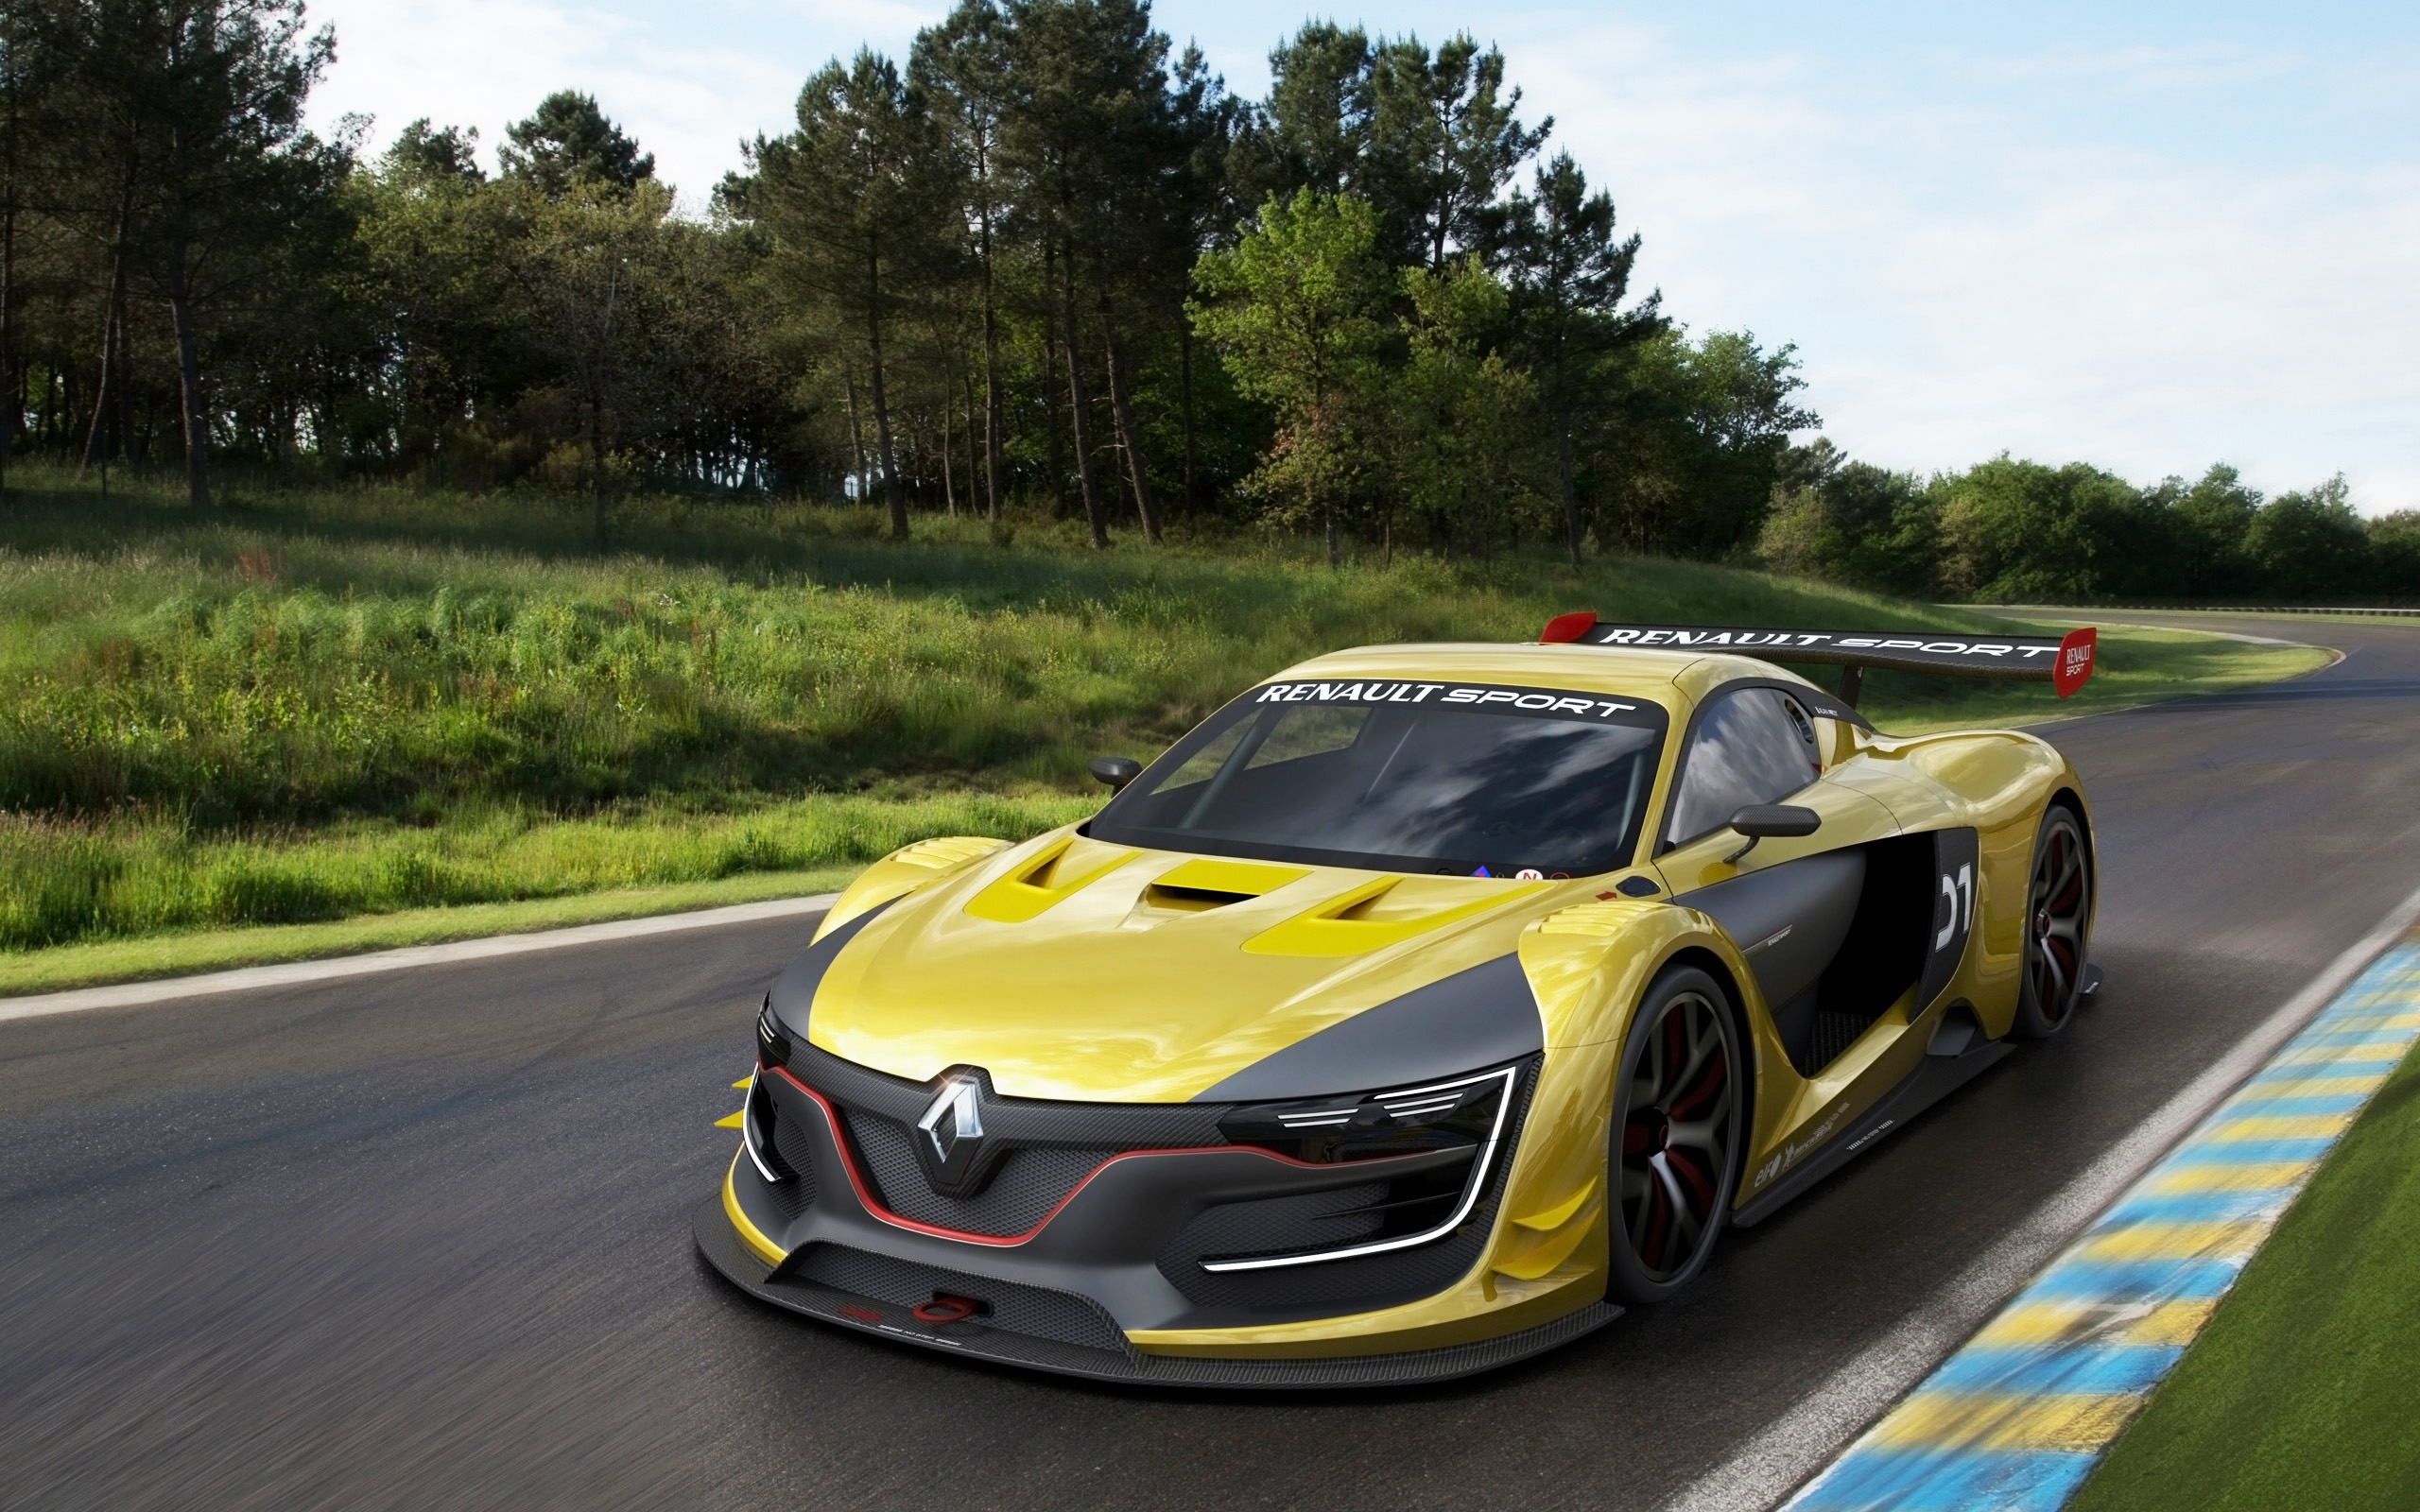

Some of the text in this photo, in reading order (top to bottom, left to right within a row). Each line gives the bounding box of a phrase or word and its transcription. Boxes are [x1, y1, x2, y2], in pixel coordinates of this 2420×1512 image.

[1599, 628, 2061, 658] RENAULT SPORT
[2066, 644, 2091, 677] RENAULT SPORT
[1255, 683, 1637, 717] RENAULT SPORT
